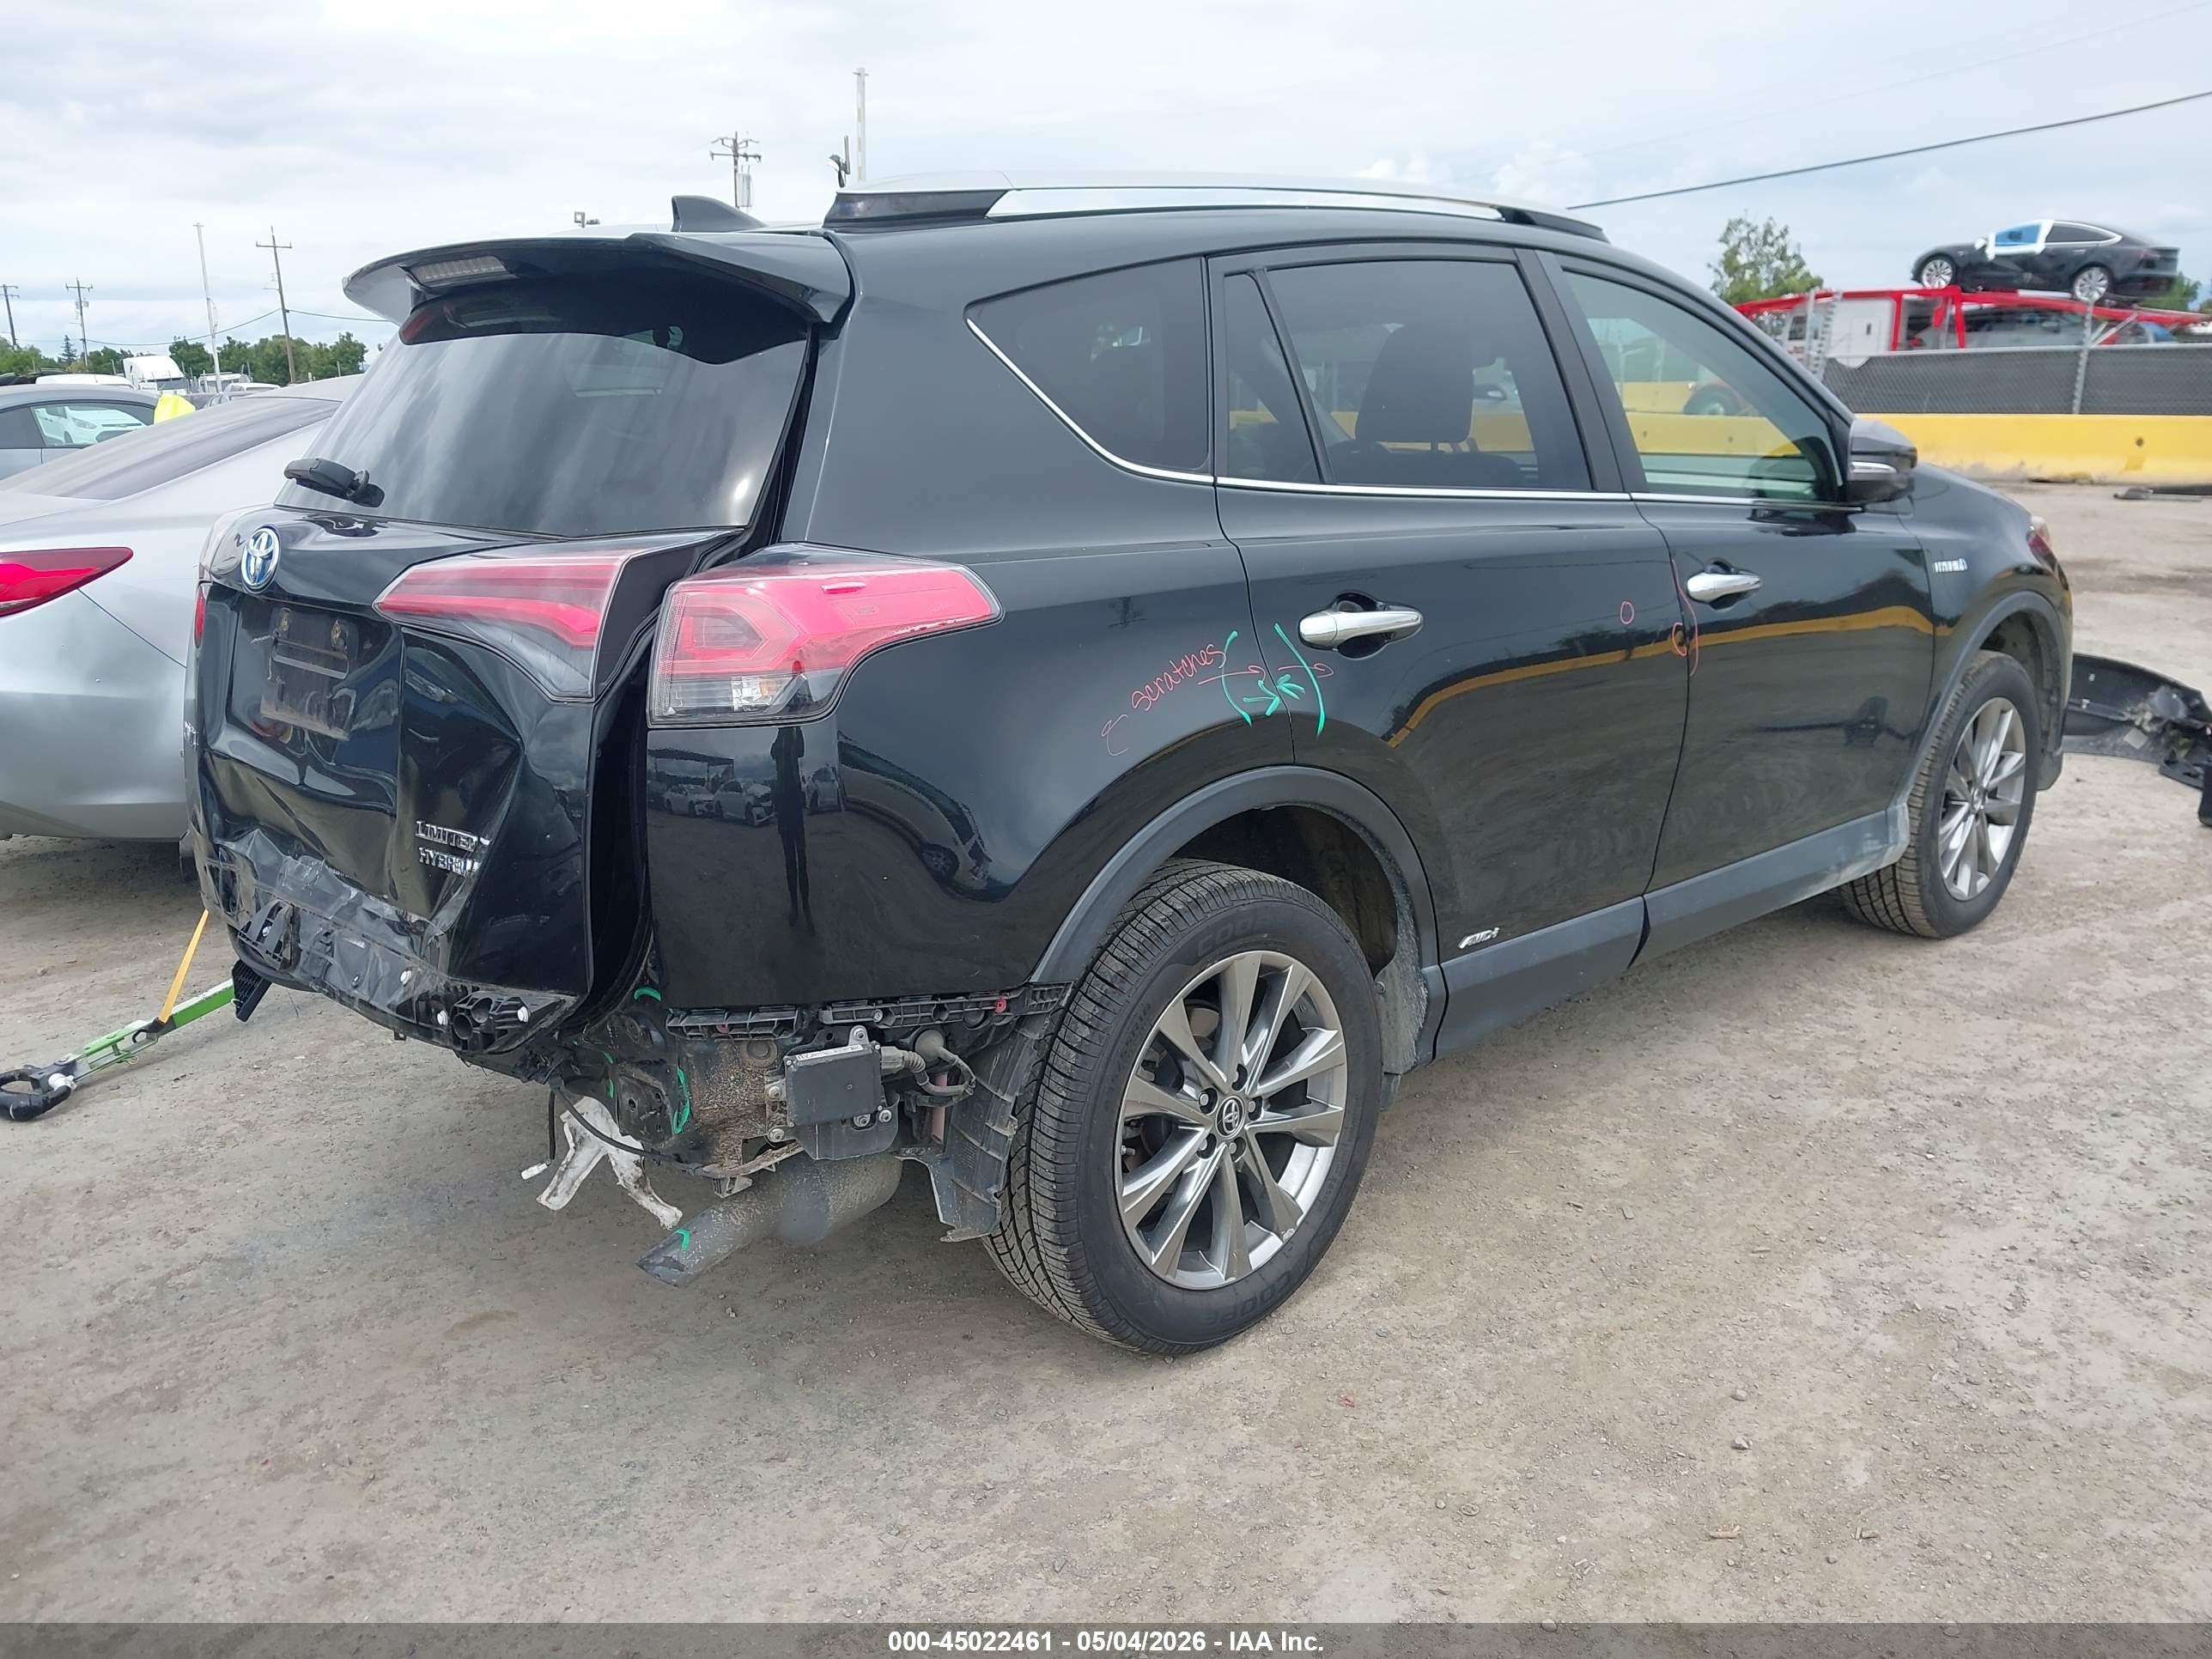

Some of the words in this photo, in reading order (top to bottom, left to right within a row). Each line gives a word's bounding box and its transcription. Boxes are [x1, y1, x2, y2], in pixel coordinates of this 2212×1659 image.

[1131, 643, 1227, 711] scratches
[415, 820, 478, 853] LIMITED
[1199, 1270, 1292, 1326] COOPE
